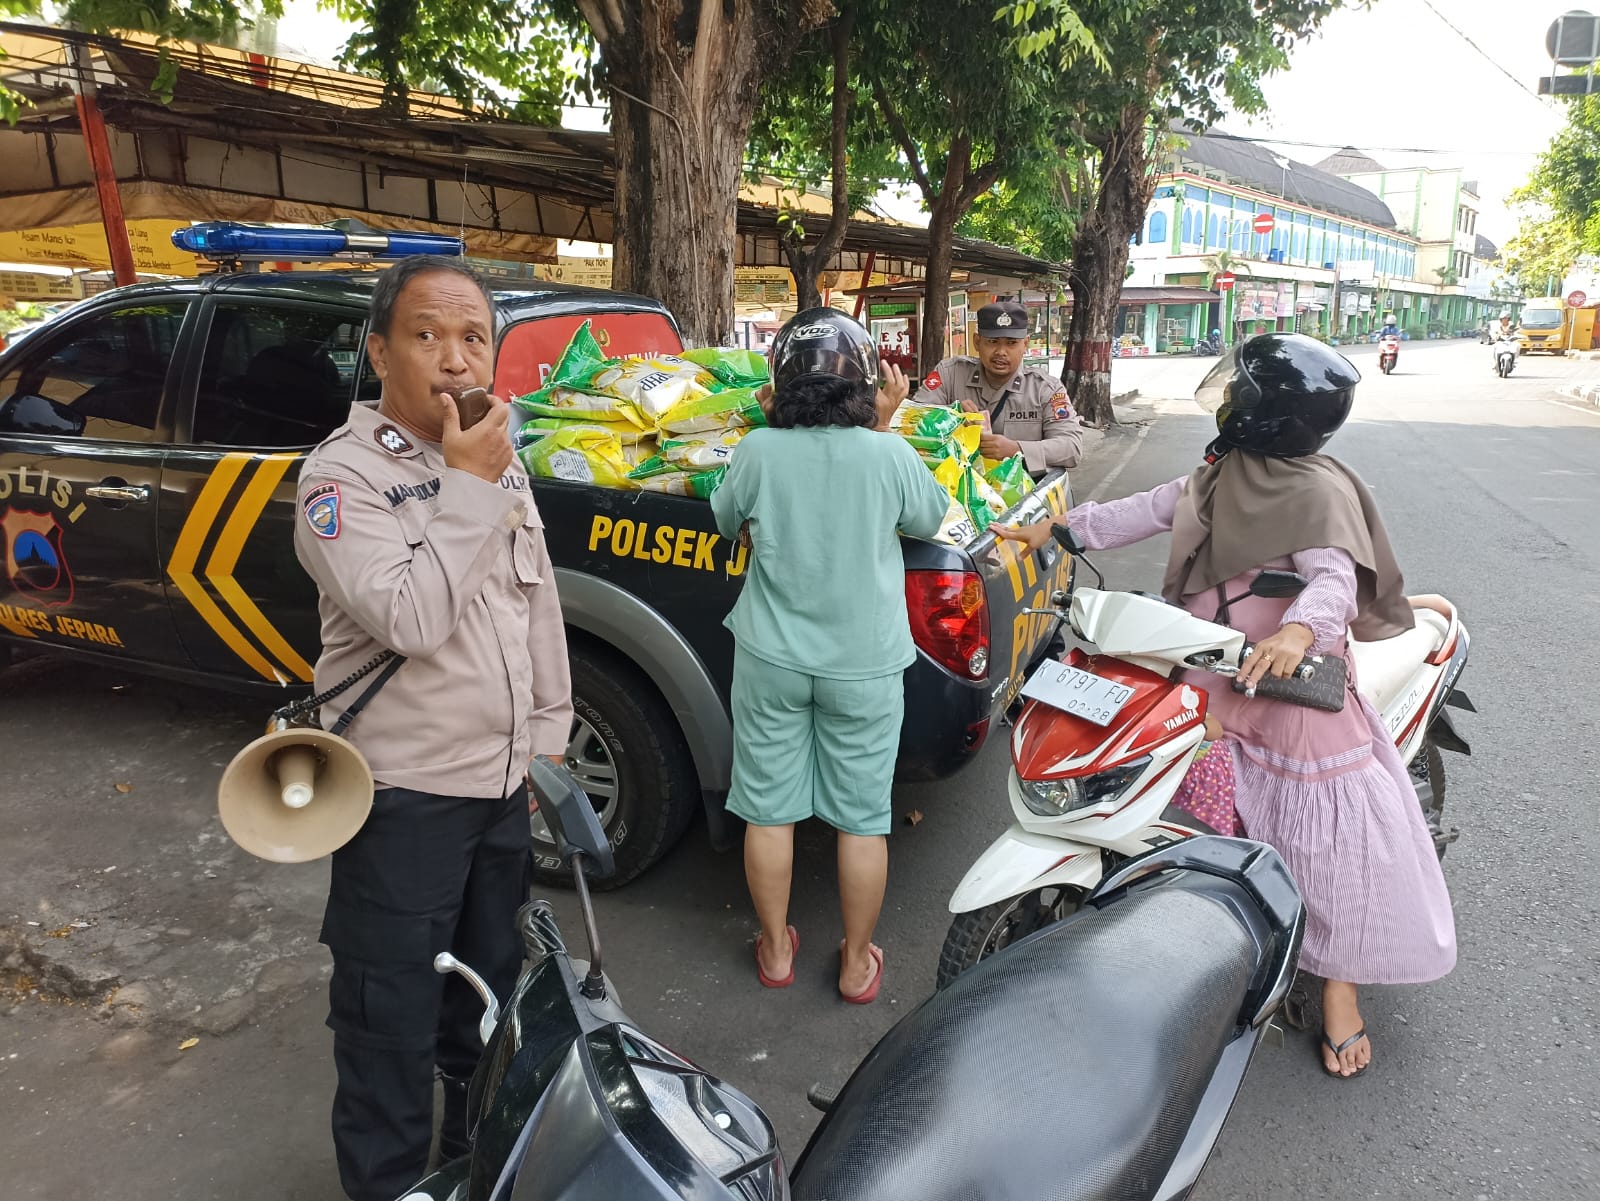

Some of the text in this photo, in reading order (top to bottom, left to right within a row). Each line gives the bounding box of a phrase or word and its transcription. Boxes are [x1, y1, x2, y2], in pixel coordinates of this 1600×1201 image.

[1009, 411, 1038, 420] POLRI
[588, 514, 721, 572] POLSEK
[0, 604, 126, 648] OLRES JEPARA
[1036, 662, 1050, 679] K
[1056, 668, 1098, 692] 6797
[1163, 709, 1199, 731] YAMAHA
